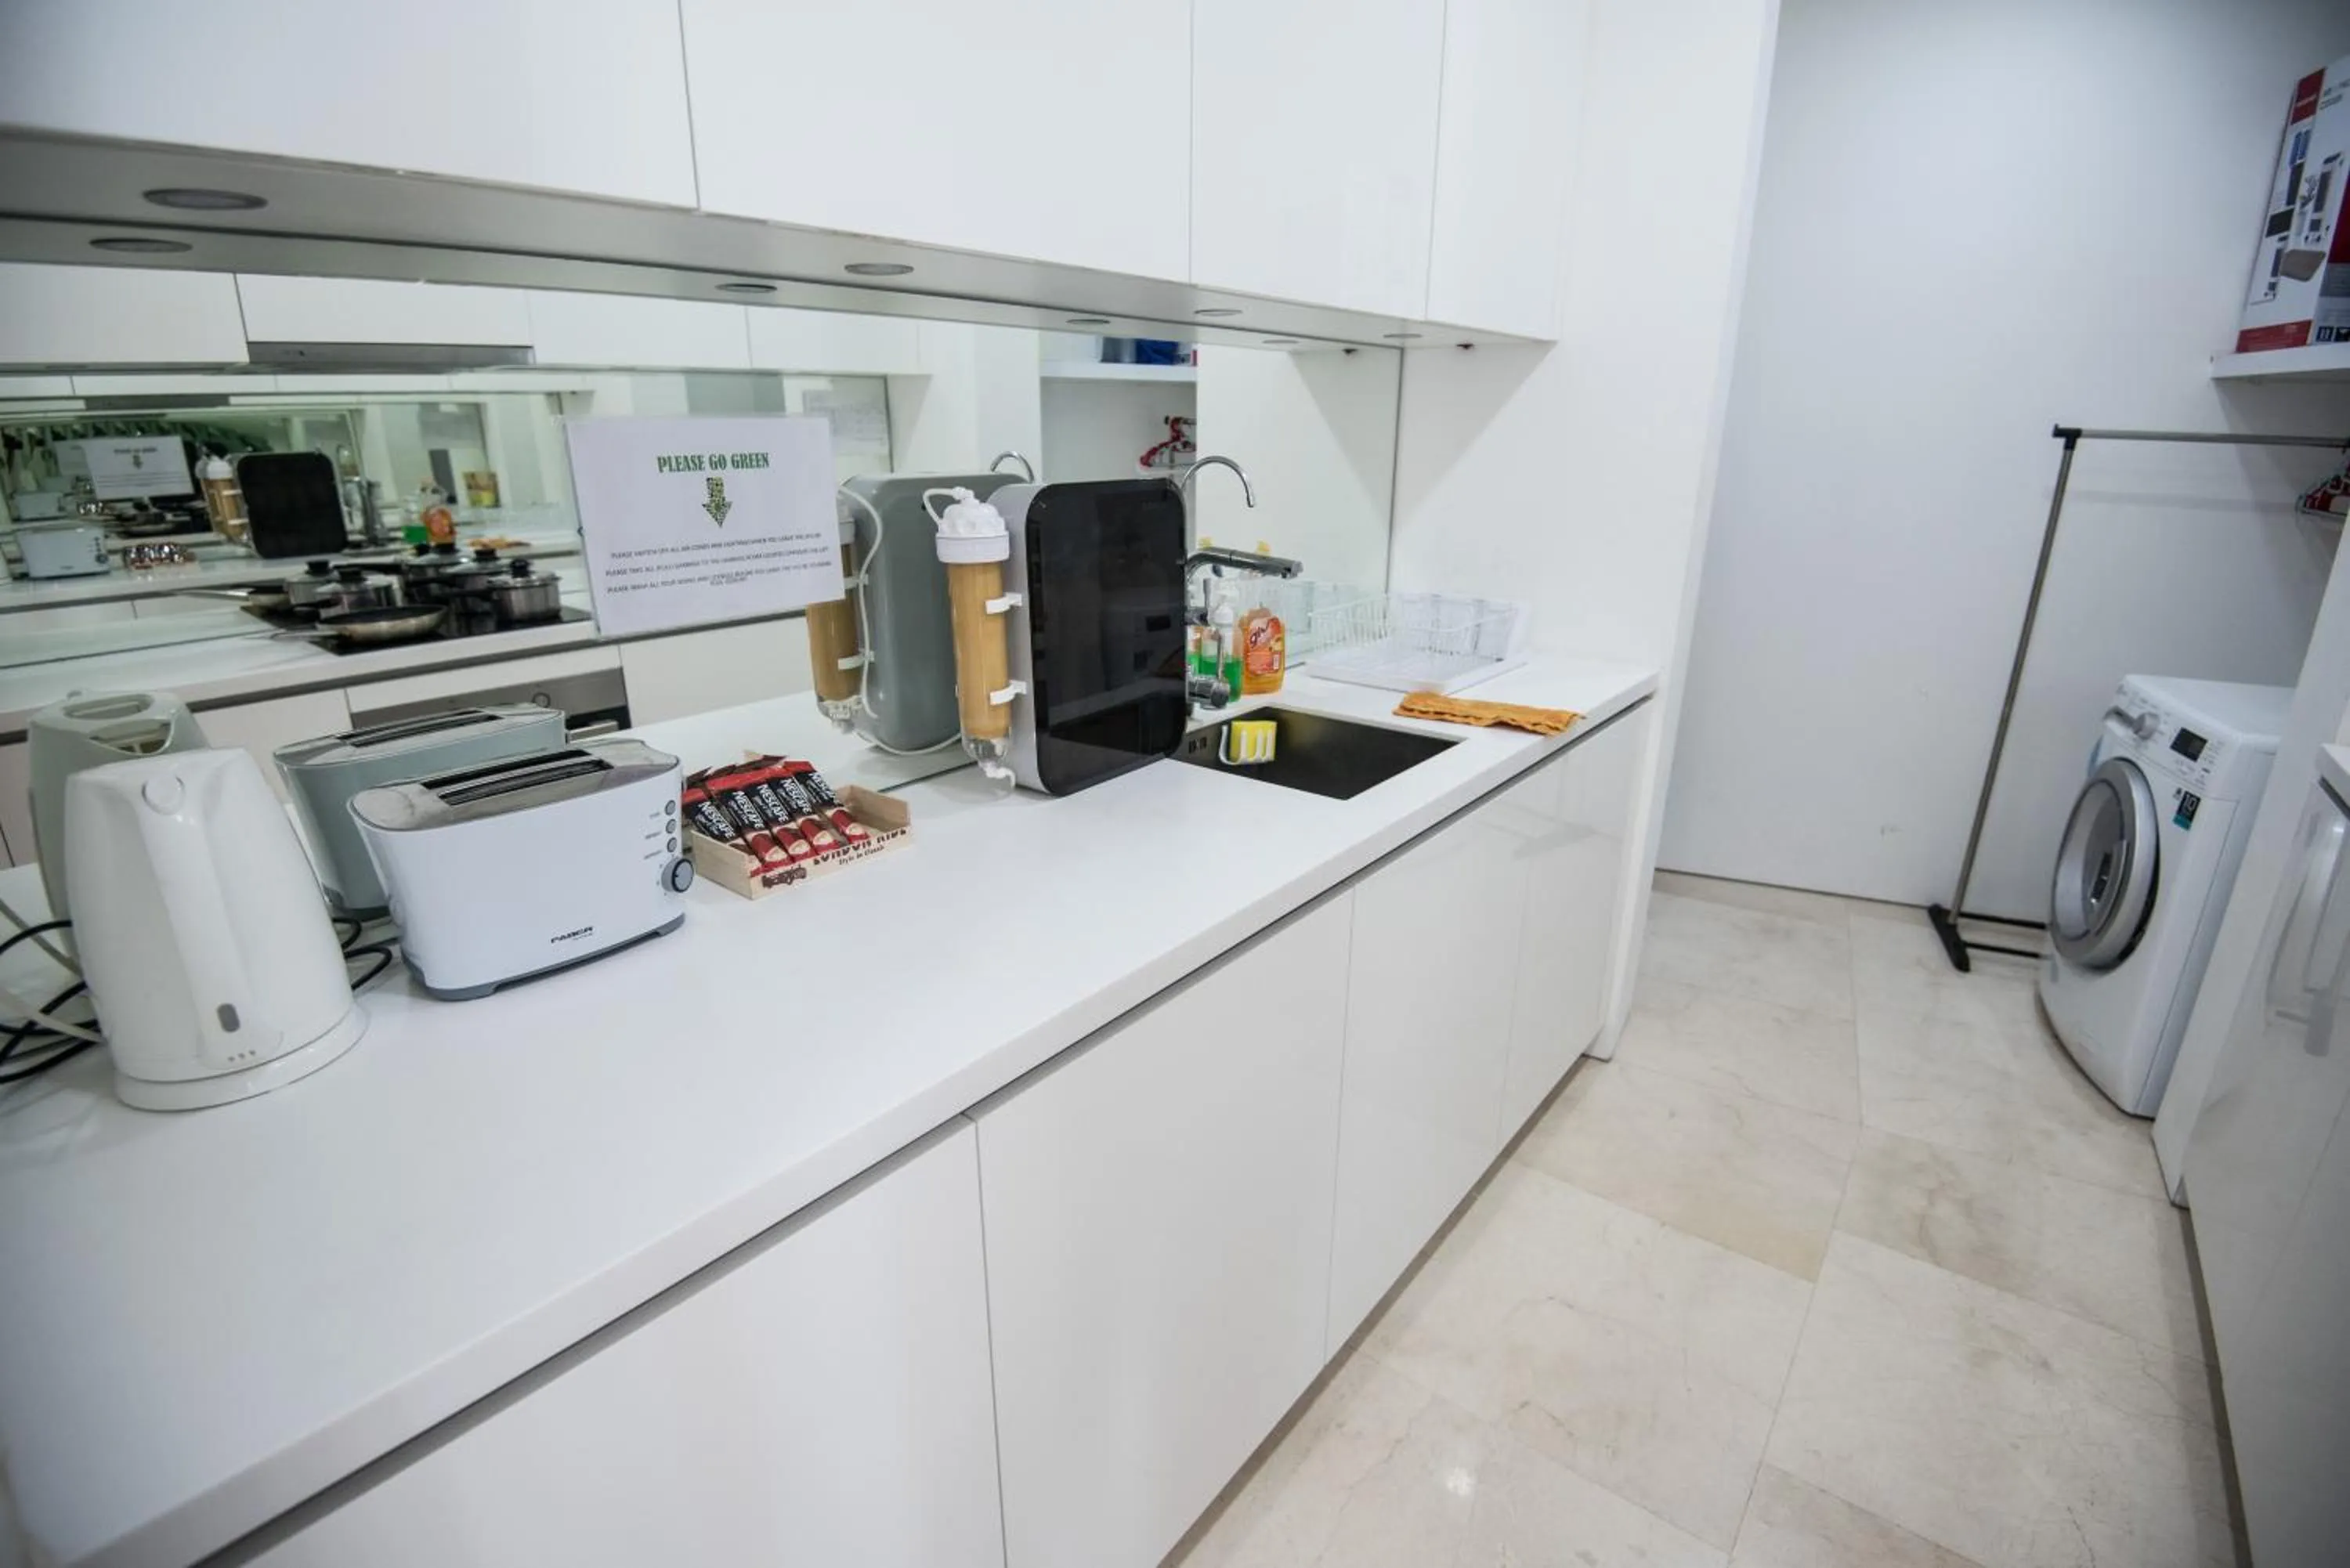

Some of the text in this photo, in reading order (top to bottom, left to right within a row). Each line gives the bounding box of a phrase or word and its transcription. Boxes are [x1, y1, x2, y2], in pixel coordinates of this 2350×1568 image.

[656, 452, 770, 473] PLEASE GO GREEN
